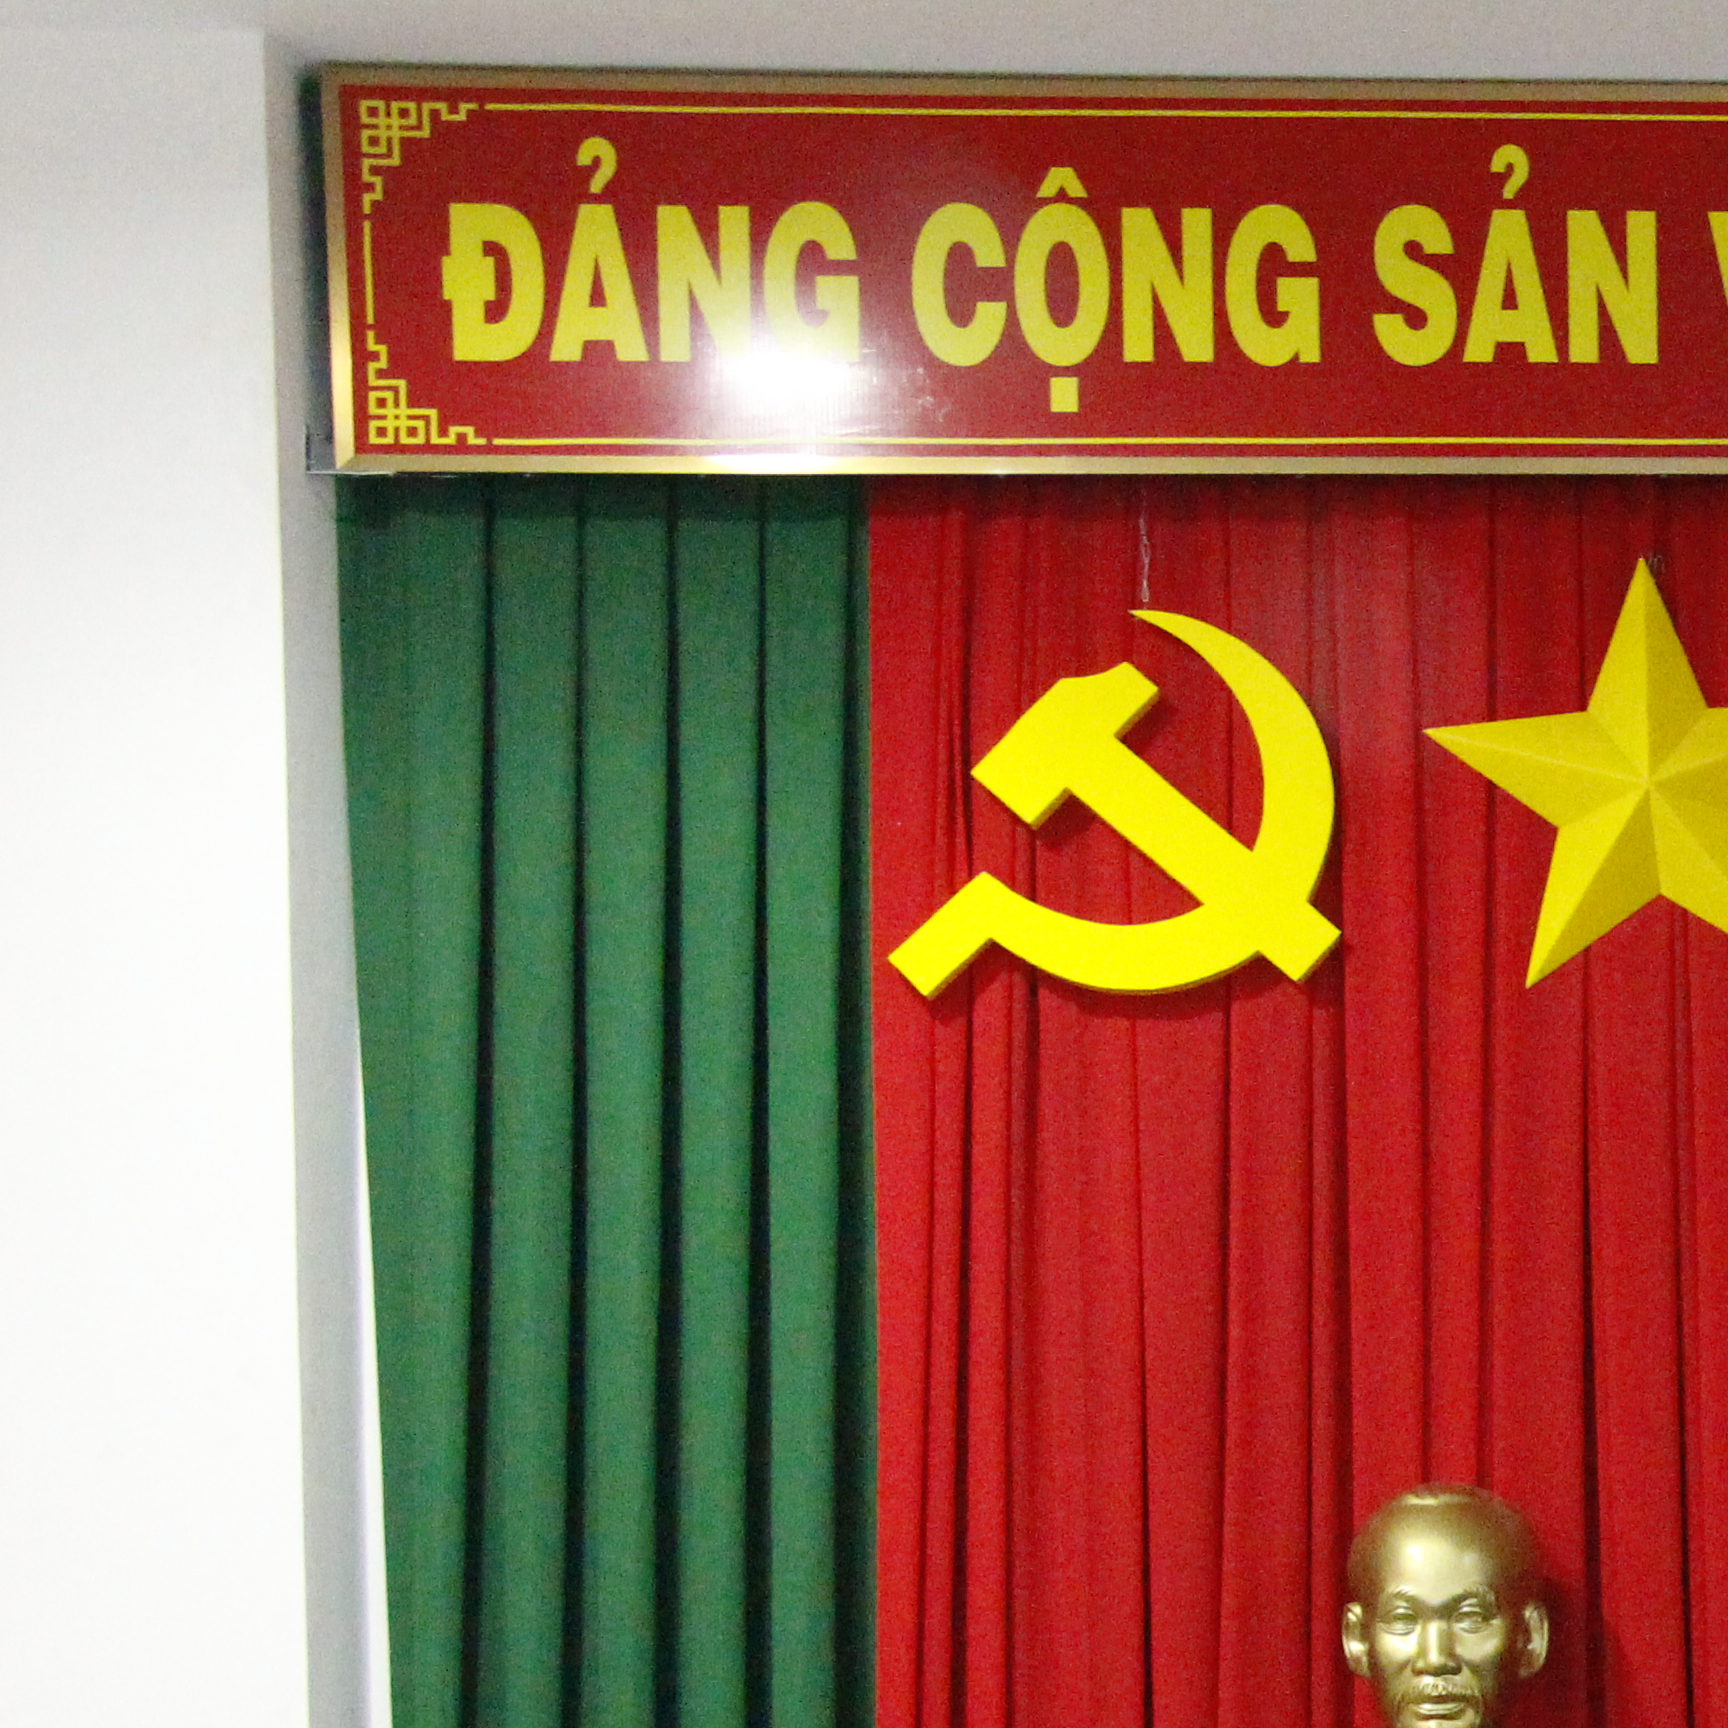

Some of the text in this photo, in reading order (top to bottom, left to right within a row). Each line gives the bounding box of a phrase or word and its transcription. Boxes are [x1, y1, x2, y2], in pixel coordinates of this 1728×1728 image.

[444, 137, 859, 364] ĐẢNG
[909, 167, 1320, 412] CỘNG
[1373, 145, 1658, 366] SẢN
